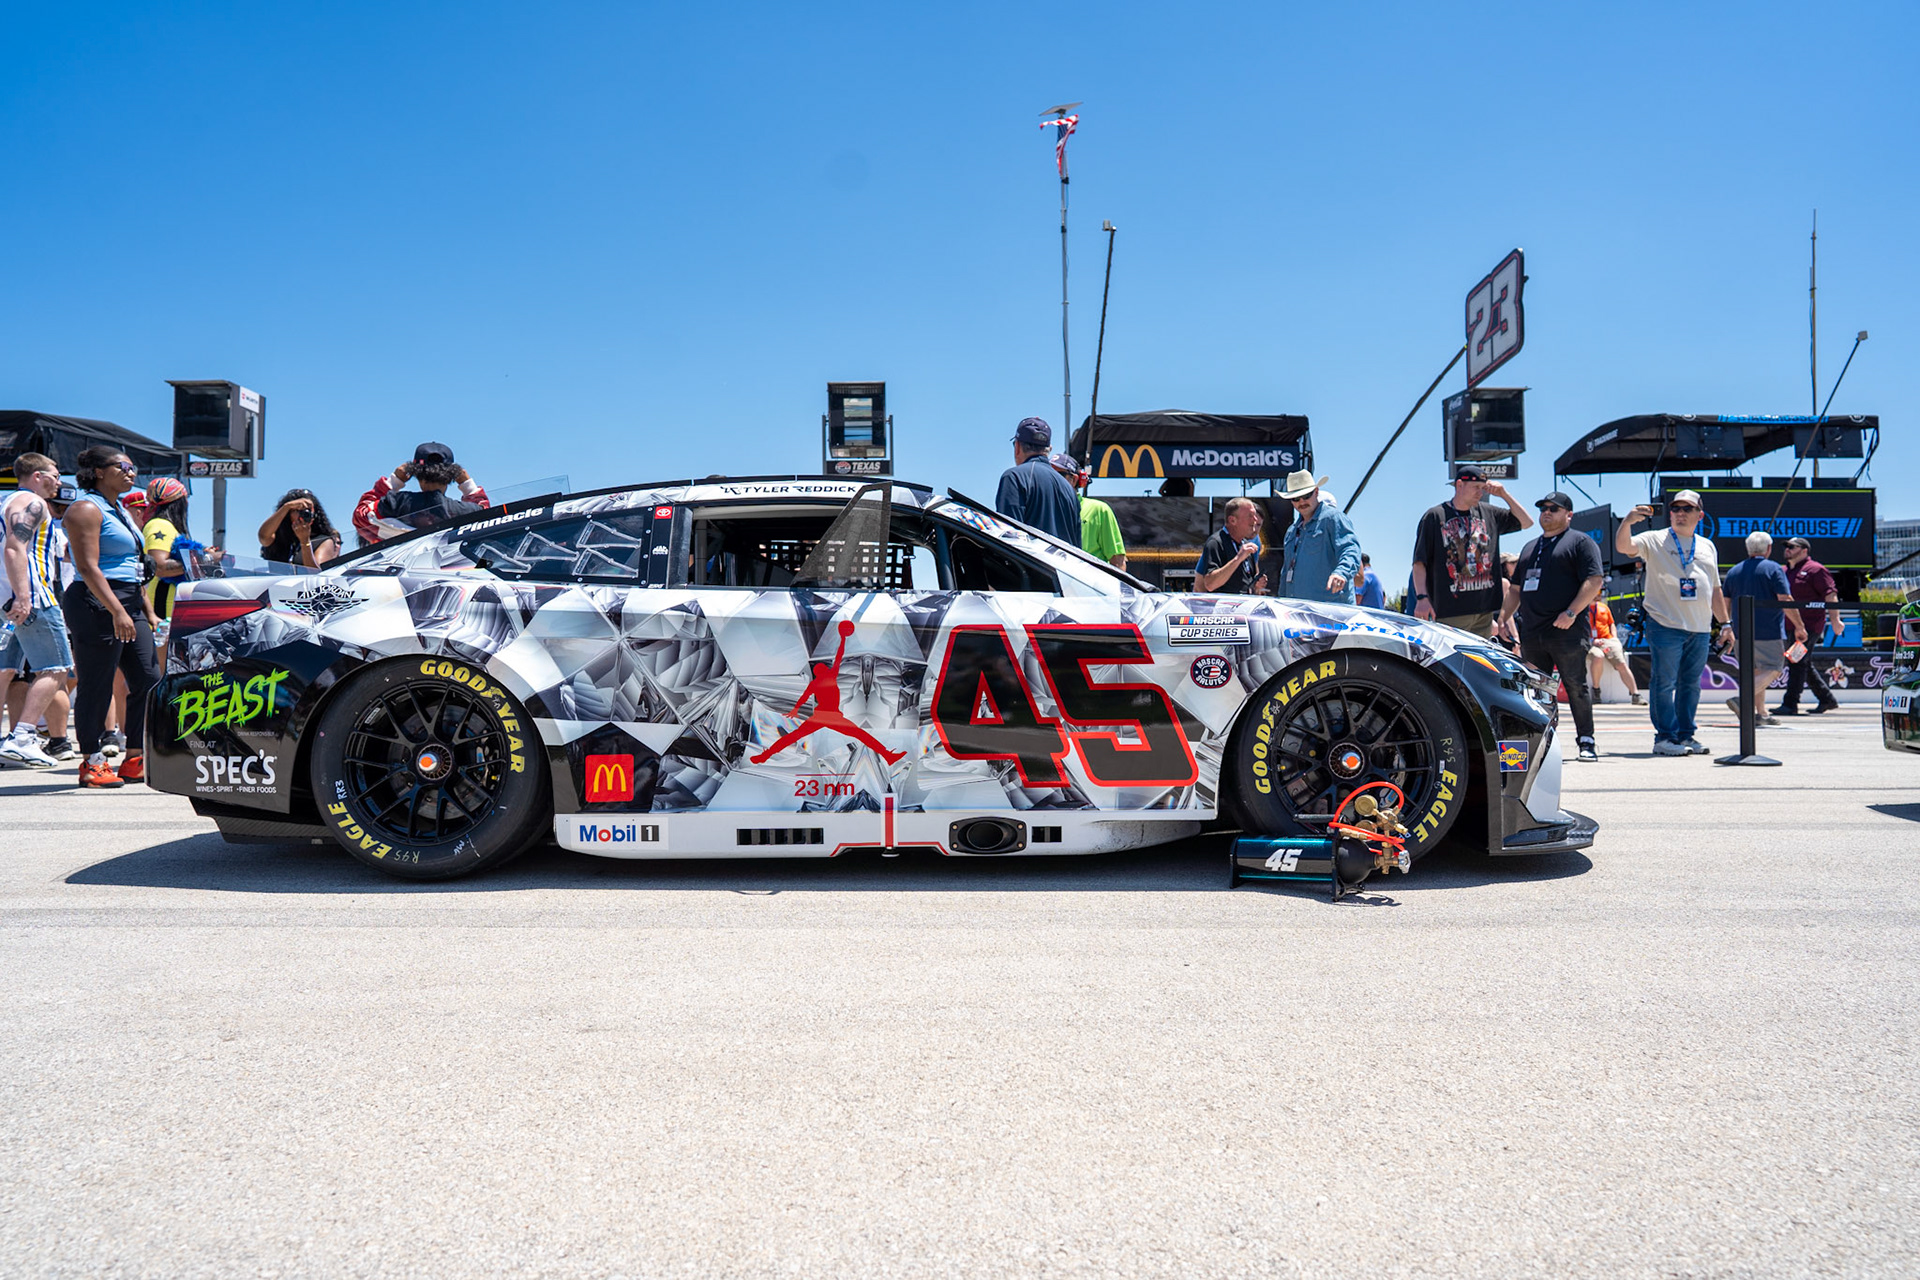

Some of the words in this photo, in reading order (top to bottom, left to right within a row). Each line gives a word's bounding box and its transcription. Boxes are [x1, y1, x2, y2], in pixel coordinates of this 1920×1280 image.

[1467, 256, 1519, 382] 23
[210, 462, 243, 472] TEXAS
[852, 462, 881, 471] TEXAS
[1171, 449, 1294, 467] McDonald's
[793, 485, 857, 493] REDDICK
[457, 507, 544, 536] Pinnacle
[1727, 519, 1839, 536] TRACKHOUSE
[299, 587, 320, 599] AIR
[319, 584, 353, 598] JORDAN
[1193, 616, 1235, 625] NASCAR
[1180, 628, 1201, 638] CUP
[1202, 627, 1239, 638] SERIES
[1196, 657, 1226, 669] NASCAR
[200, 672, 225, 688] THE
[1195, 674, 1228, 686] SALUTES
[931, 624, 1200, 788] 45
[420, 659, 525, 774] GOODYEAR
[1252, 660, 1337, 794] GOODYEAR
[196, 749, 277, 785] SPEC'S
[335, 780, 347, 799] RR3
[795, 780, 819, 797] 23
[823, 782, 855, 796] nm
[1413, 769, 1458, 843] EAGLE
[327, 802, 393, 859] EAGLE
[579, 825, 637, 843] Mobil
[1264, 848, 1303, 872] 45
